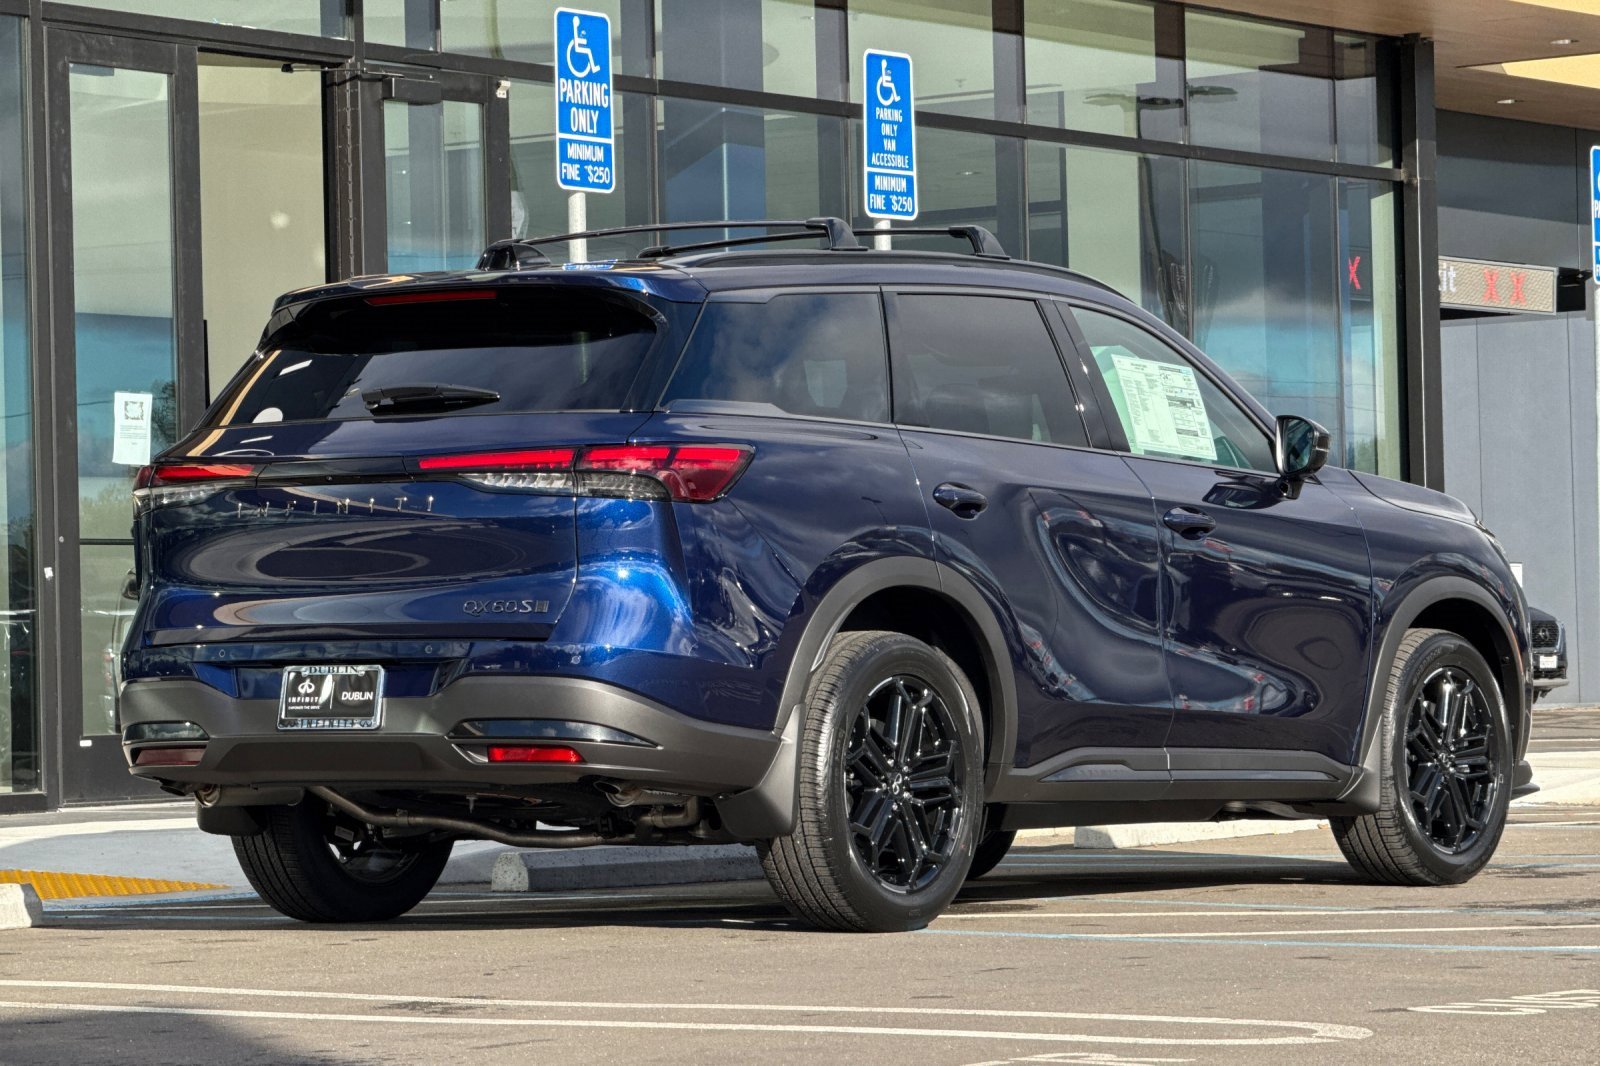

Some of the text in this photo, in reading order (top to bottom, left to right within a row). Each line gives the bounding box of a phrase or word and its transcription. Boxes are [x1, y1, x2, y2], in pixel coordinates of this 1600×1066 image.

[559, 78, 609, 108] PARKING
[570, 107, 599, 134] ONLY
[876, 107, 903, 123] PARKING
[881, 123, 898, 137] ONLY
[567, 142, 604, 162] MINIMUM
[883, 139, 896, 152] VAN
[871, 154, 909, 169] ACCESSIBLE
[561, 162, 611, 185] FINE $250
[874, 175, 907, 193] MINIMUM
[869, 193, 913, 213] FINE $250
[1438, 262, 1457, 293] it
[237, 496, 435, 518] INFINITI
[309, 666, 359, 674] DUBLIN
[341, 691, 374, 701] DUBLIN
